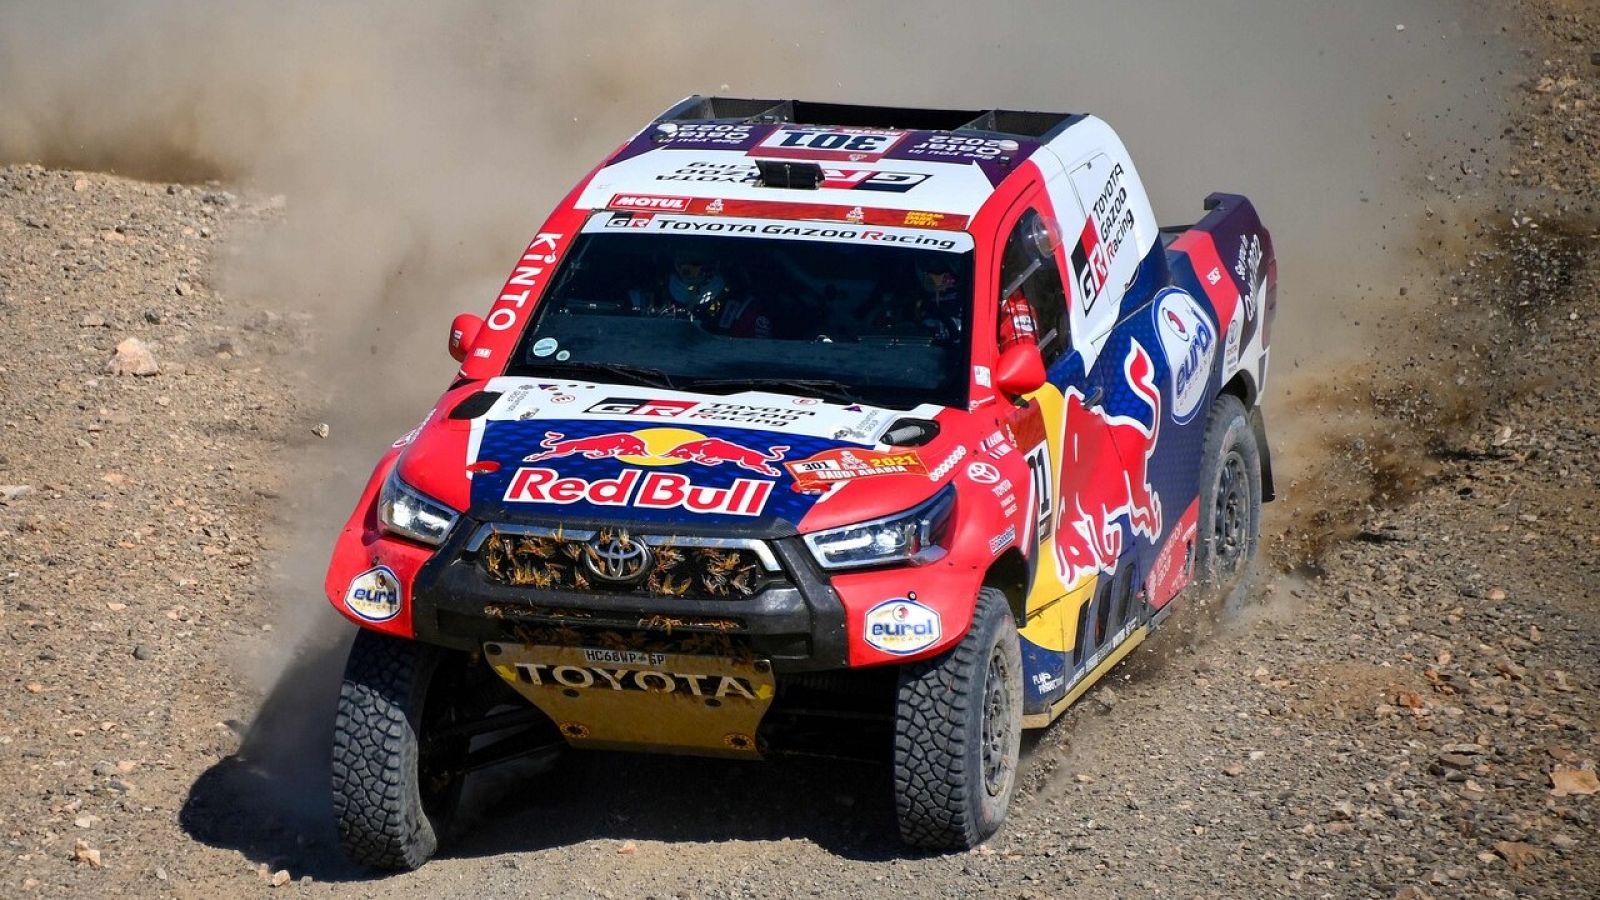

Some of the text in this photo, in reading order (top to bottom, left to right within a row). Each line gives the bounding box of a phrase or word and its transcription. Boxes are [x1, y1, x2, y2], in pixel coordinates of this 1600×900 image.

[780, 131, 887, 151] 301
[913, 142, 1001, 156] Qatar
[1093, 162, 1125, 222] TOYOTA
[614, 197, 684, 208] MOTUL
[1100, 186, 1127, 243] GAZOO
[606, 214, 956, 249] GR TOYOTA GAZOO Racing
[1106, 208, 1135, 266] Racing
[1176, 306, 1212, 399] eurol
[583, 400, 690, 417] GR
[698, 408, 800, 421] GAZOO
[711, 402, 816, 416] TOYOTA
[689, 414, 789, 427] Racing
[803, 461, 832, 471] 301
[869, 455, 920, 468] 2021
[816, 465, 908, 480] SAUDI ARABIA
[503, 467, 775, 516] Red Bull
[872, 619, 933, 636] eurol
[514, 662, 757, 700] TOYOTA
